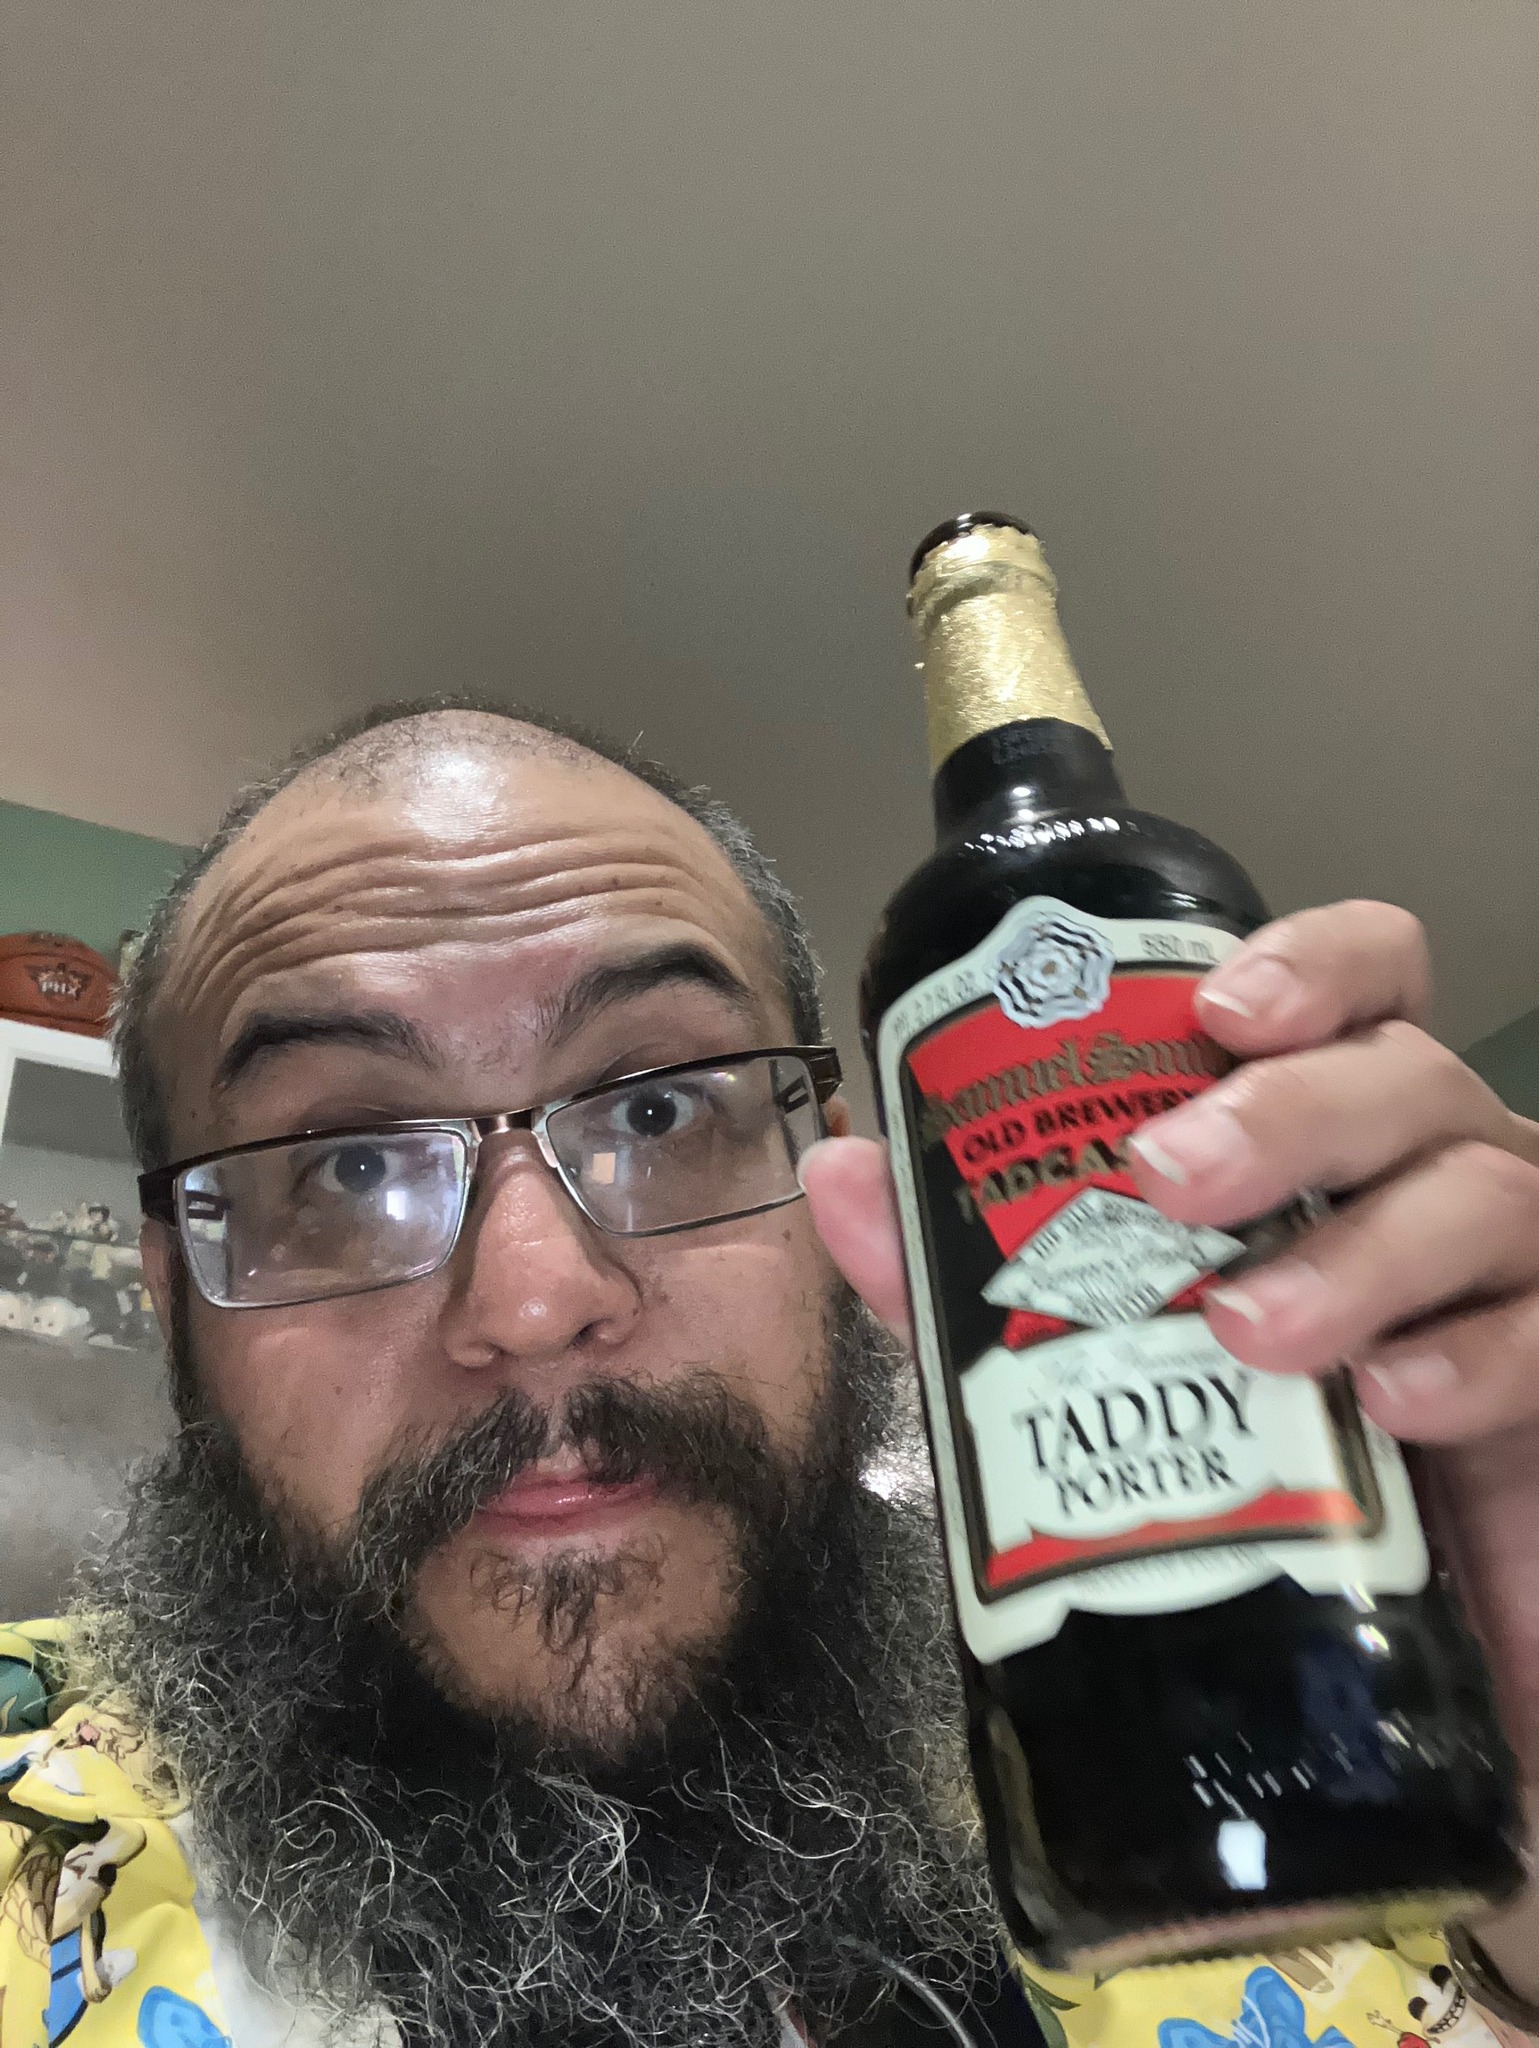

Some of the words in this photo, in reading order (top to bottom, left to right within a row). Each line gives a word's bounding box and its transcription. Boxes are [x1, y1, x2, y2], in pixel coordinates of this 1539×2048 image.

[41, 980, 79, 998] PHX
[963, 1120, 1027, 1164] OLD
[1011, 1367, 1258, 1476] TADDY
[1053, 1443, 1243, 1519] PORTER
